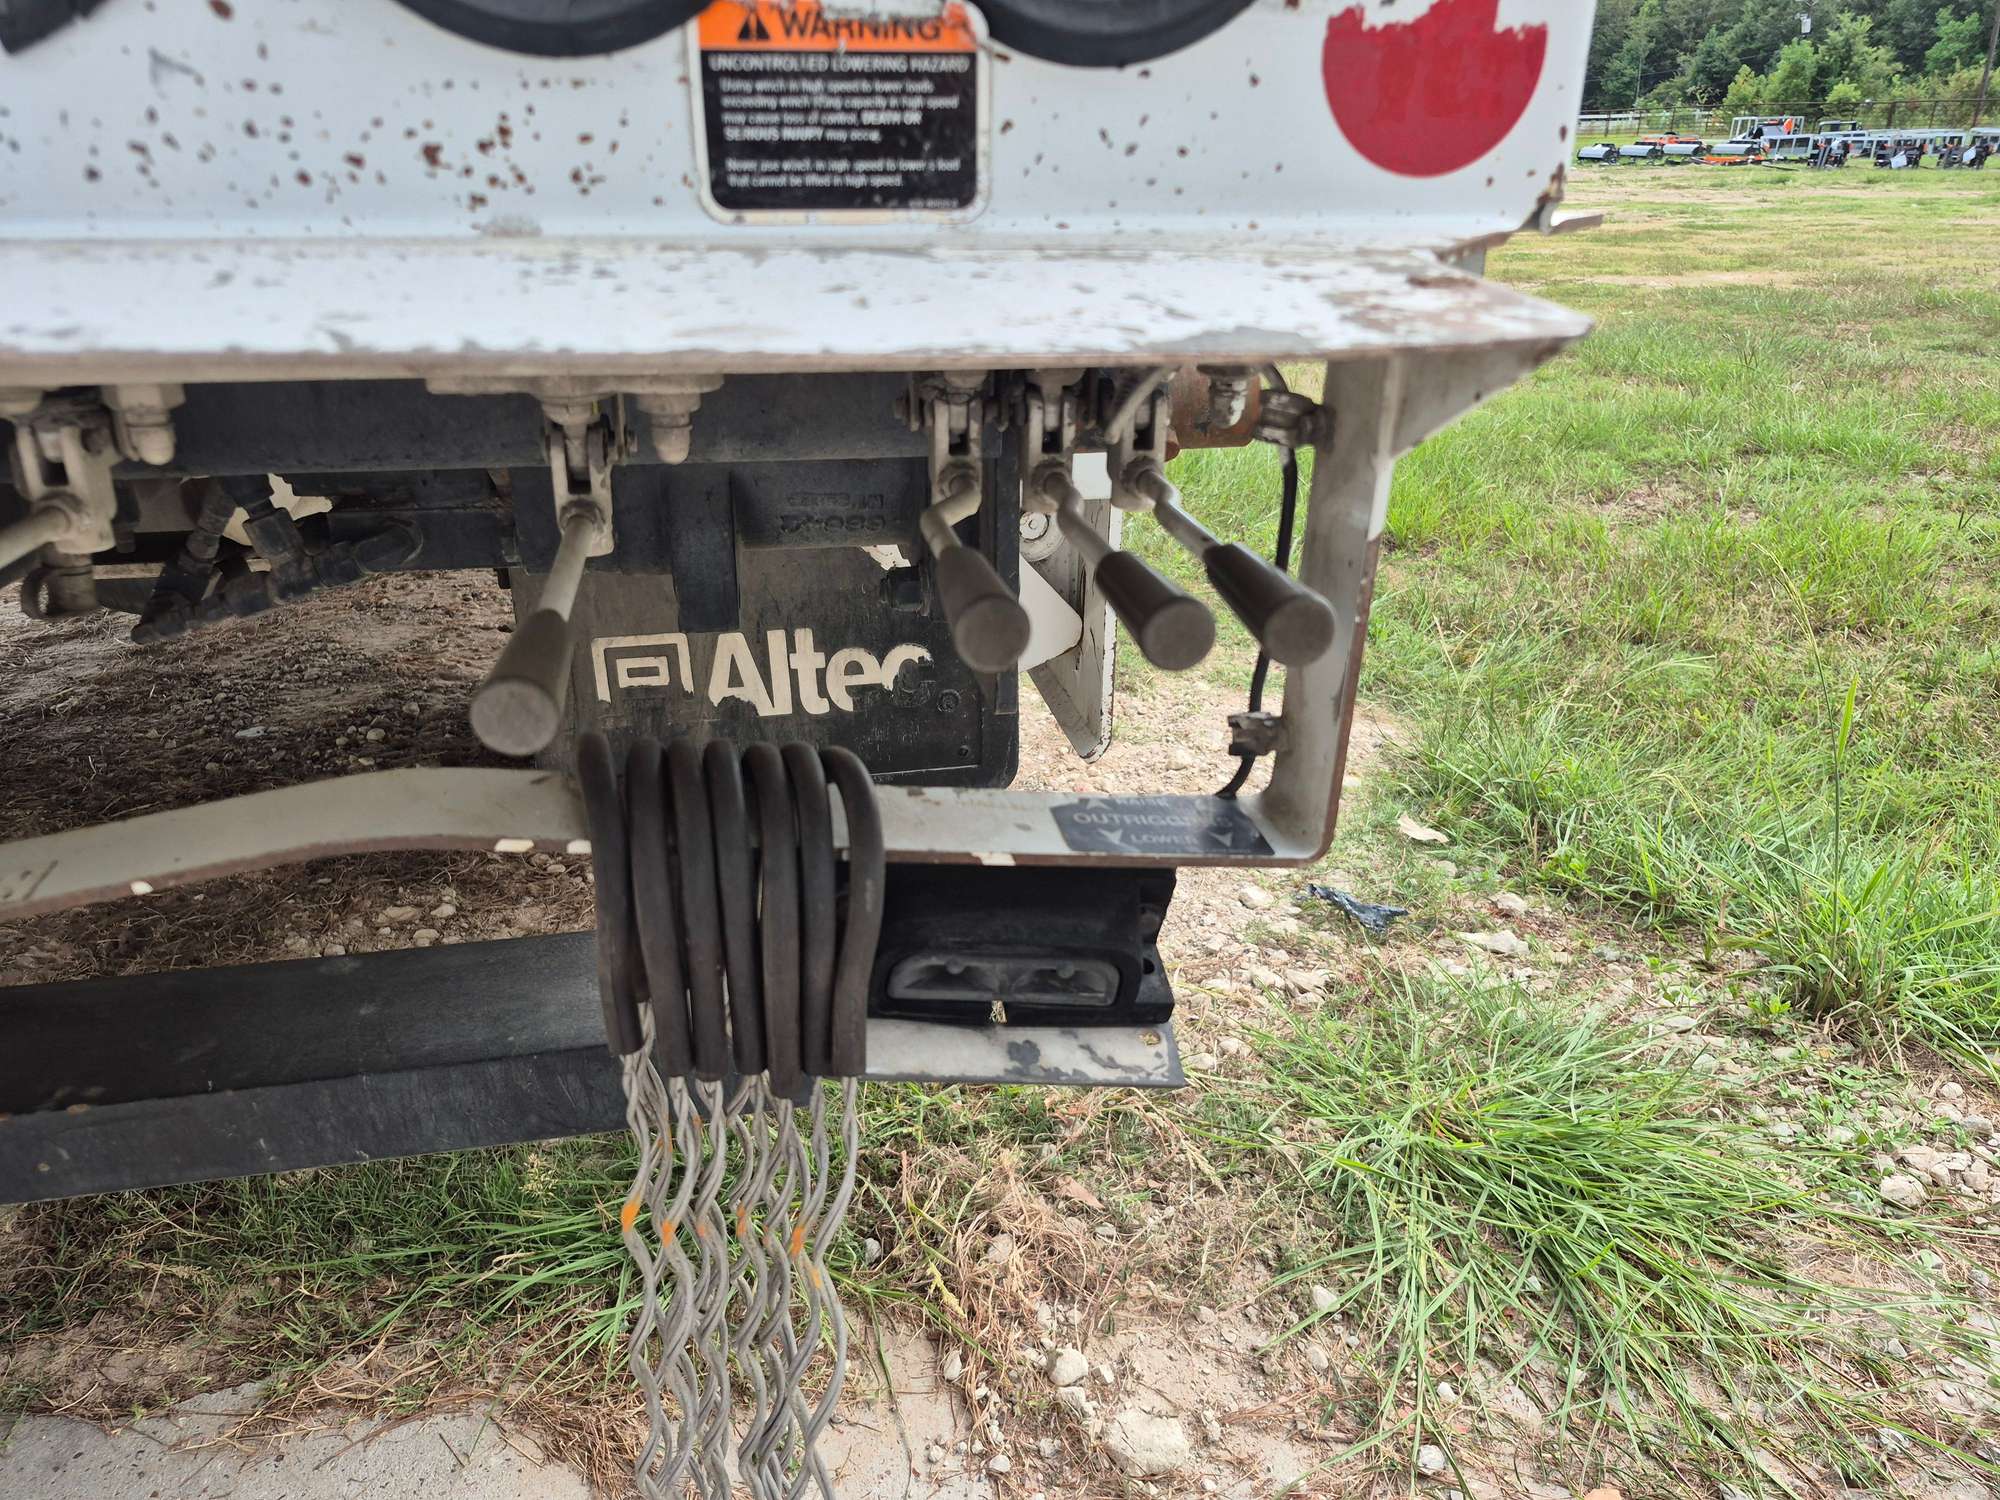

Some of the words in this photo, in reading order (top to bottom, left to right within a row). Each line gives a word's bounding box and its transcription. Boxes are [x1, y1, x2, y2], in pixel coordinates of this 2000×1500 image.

[776, 7, 943, 41] WARNING
[708, 54, 829, 73] UNCONTROLLED
[831, 54, 908, 73] LOWERING
[910, 55, 970, 73] HAZARD
[720, 78, 752, 94] Using
[755, 79, 784, 93] winch
[789, 79, 799, 93] in
[826, 79, 860, 94] speed
[860, 79, 872, 93] to
[874, 79, 903, 93] lower
[926, 95, 959, 110] speed
[721, 112, 746, 127] may
[748, 112, 780, 125] cause
[784, 112, 805, 125] loss
[808, 112, 819, 125] of
[861, 110, 900, 126] DEATH
[902, 110, 922, 126] OR
[724, 126, 780, 141] SERIOUS
[781, 126, 824, 141] INJURY
[824, 128, 848, 143] may
[725, 158, 757, 172] Never
[760, 159, 780, 172] use
[782, 158, 811, 172] winch
[828, 158, 849, 173] high
[853, 158, 884, 173] speed
[886, 158, 897, 171] to
[899, 158, 926, 171] lower
[937, 158, 961, 171] load
[727, 173, 751, 188] that
[751, 174, 787, 187] cannot
[789, 173, 803, 187] be
[833, 174, 843, 187] in
[845, 173, 866, 188] high
[1129, 833, 1200, 846] LOWER
